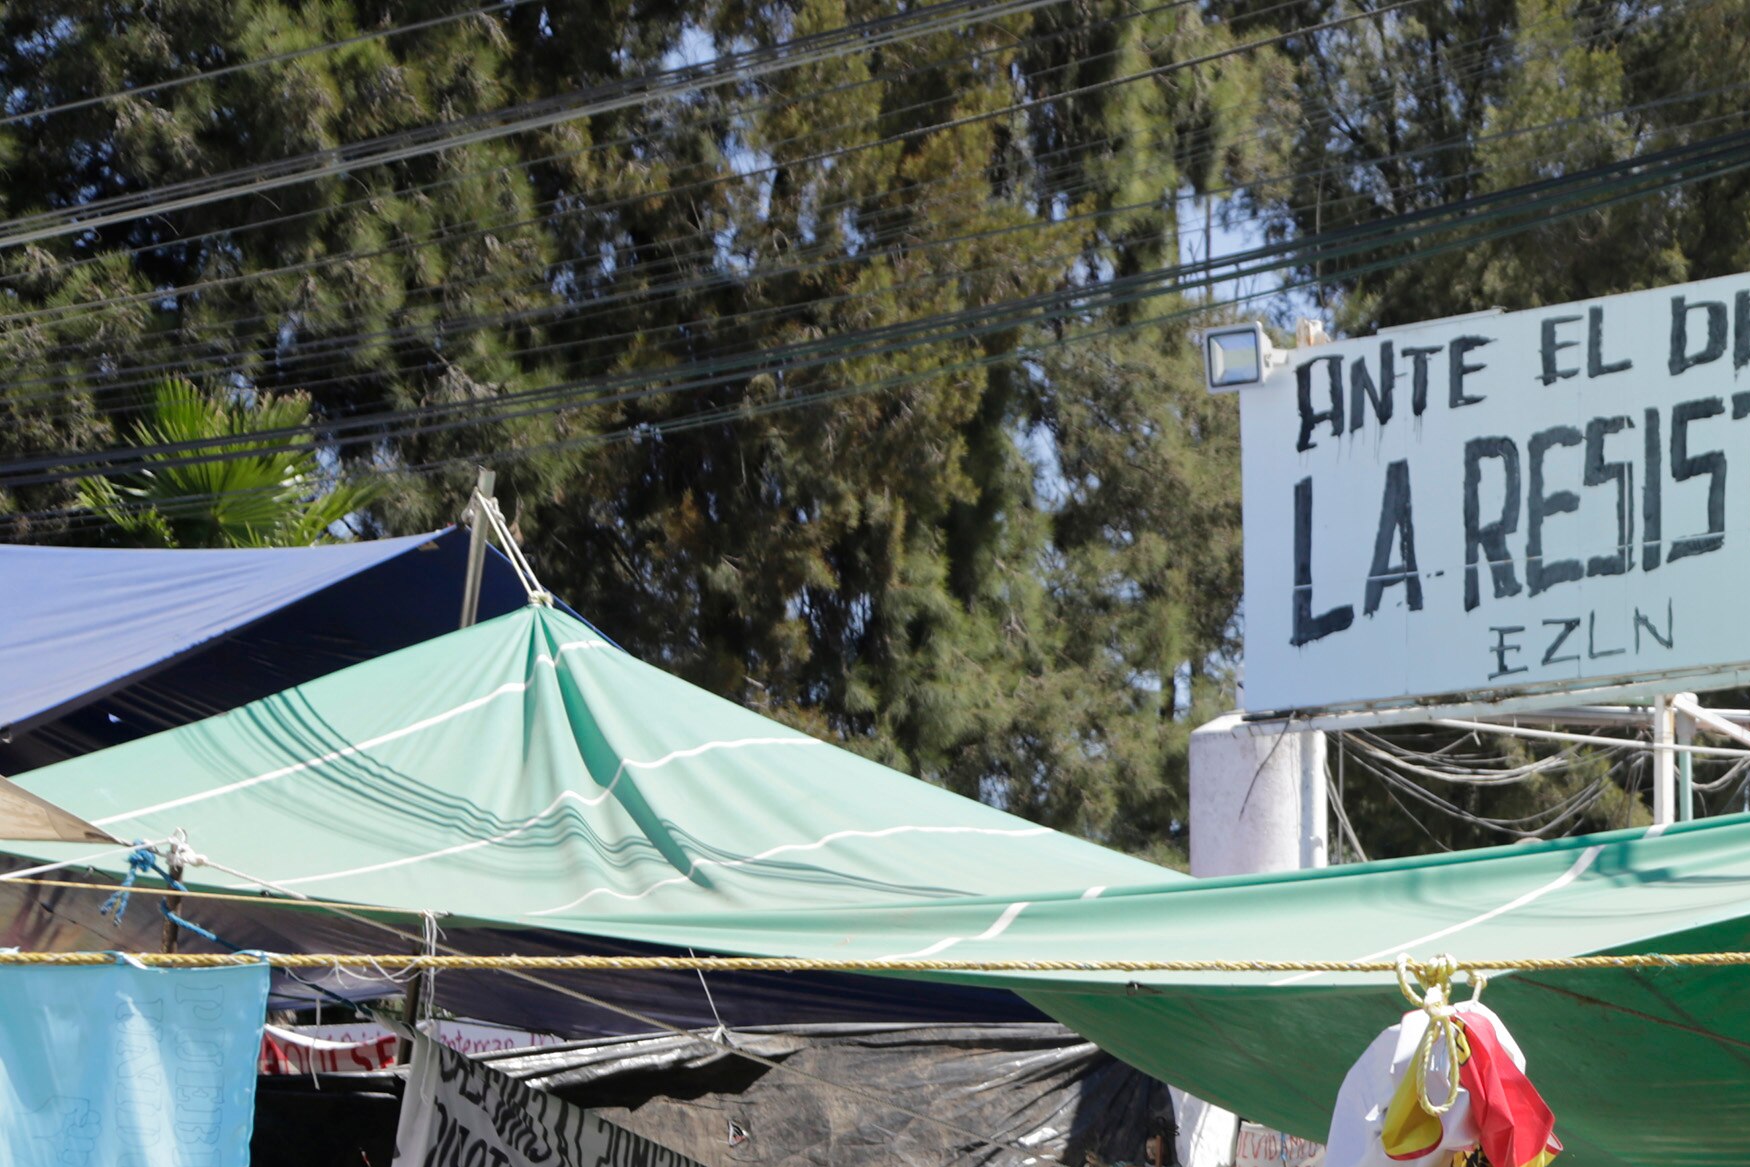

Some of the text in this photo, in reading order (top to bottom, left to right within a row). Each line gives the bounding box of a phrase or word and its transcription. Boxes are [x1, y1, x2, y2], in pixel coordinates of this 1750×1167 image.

[1296, 336, 1495, 452] ANTE
[1537, 306, 1633, 386] EL
[1291, 459, 1423, 647] LA
[1488, 599, 1674, 680] EZLN
